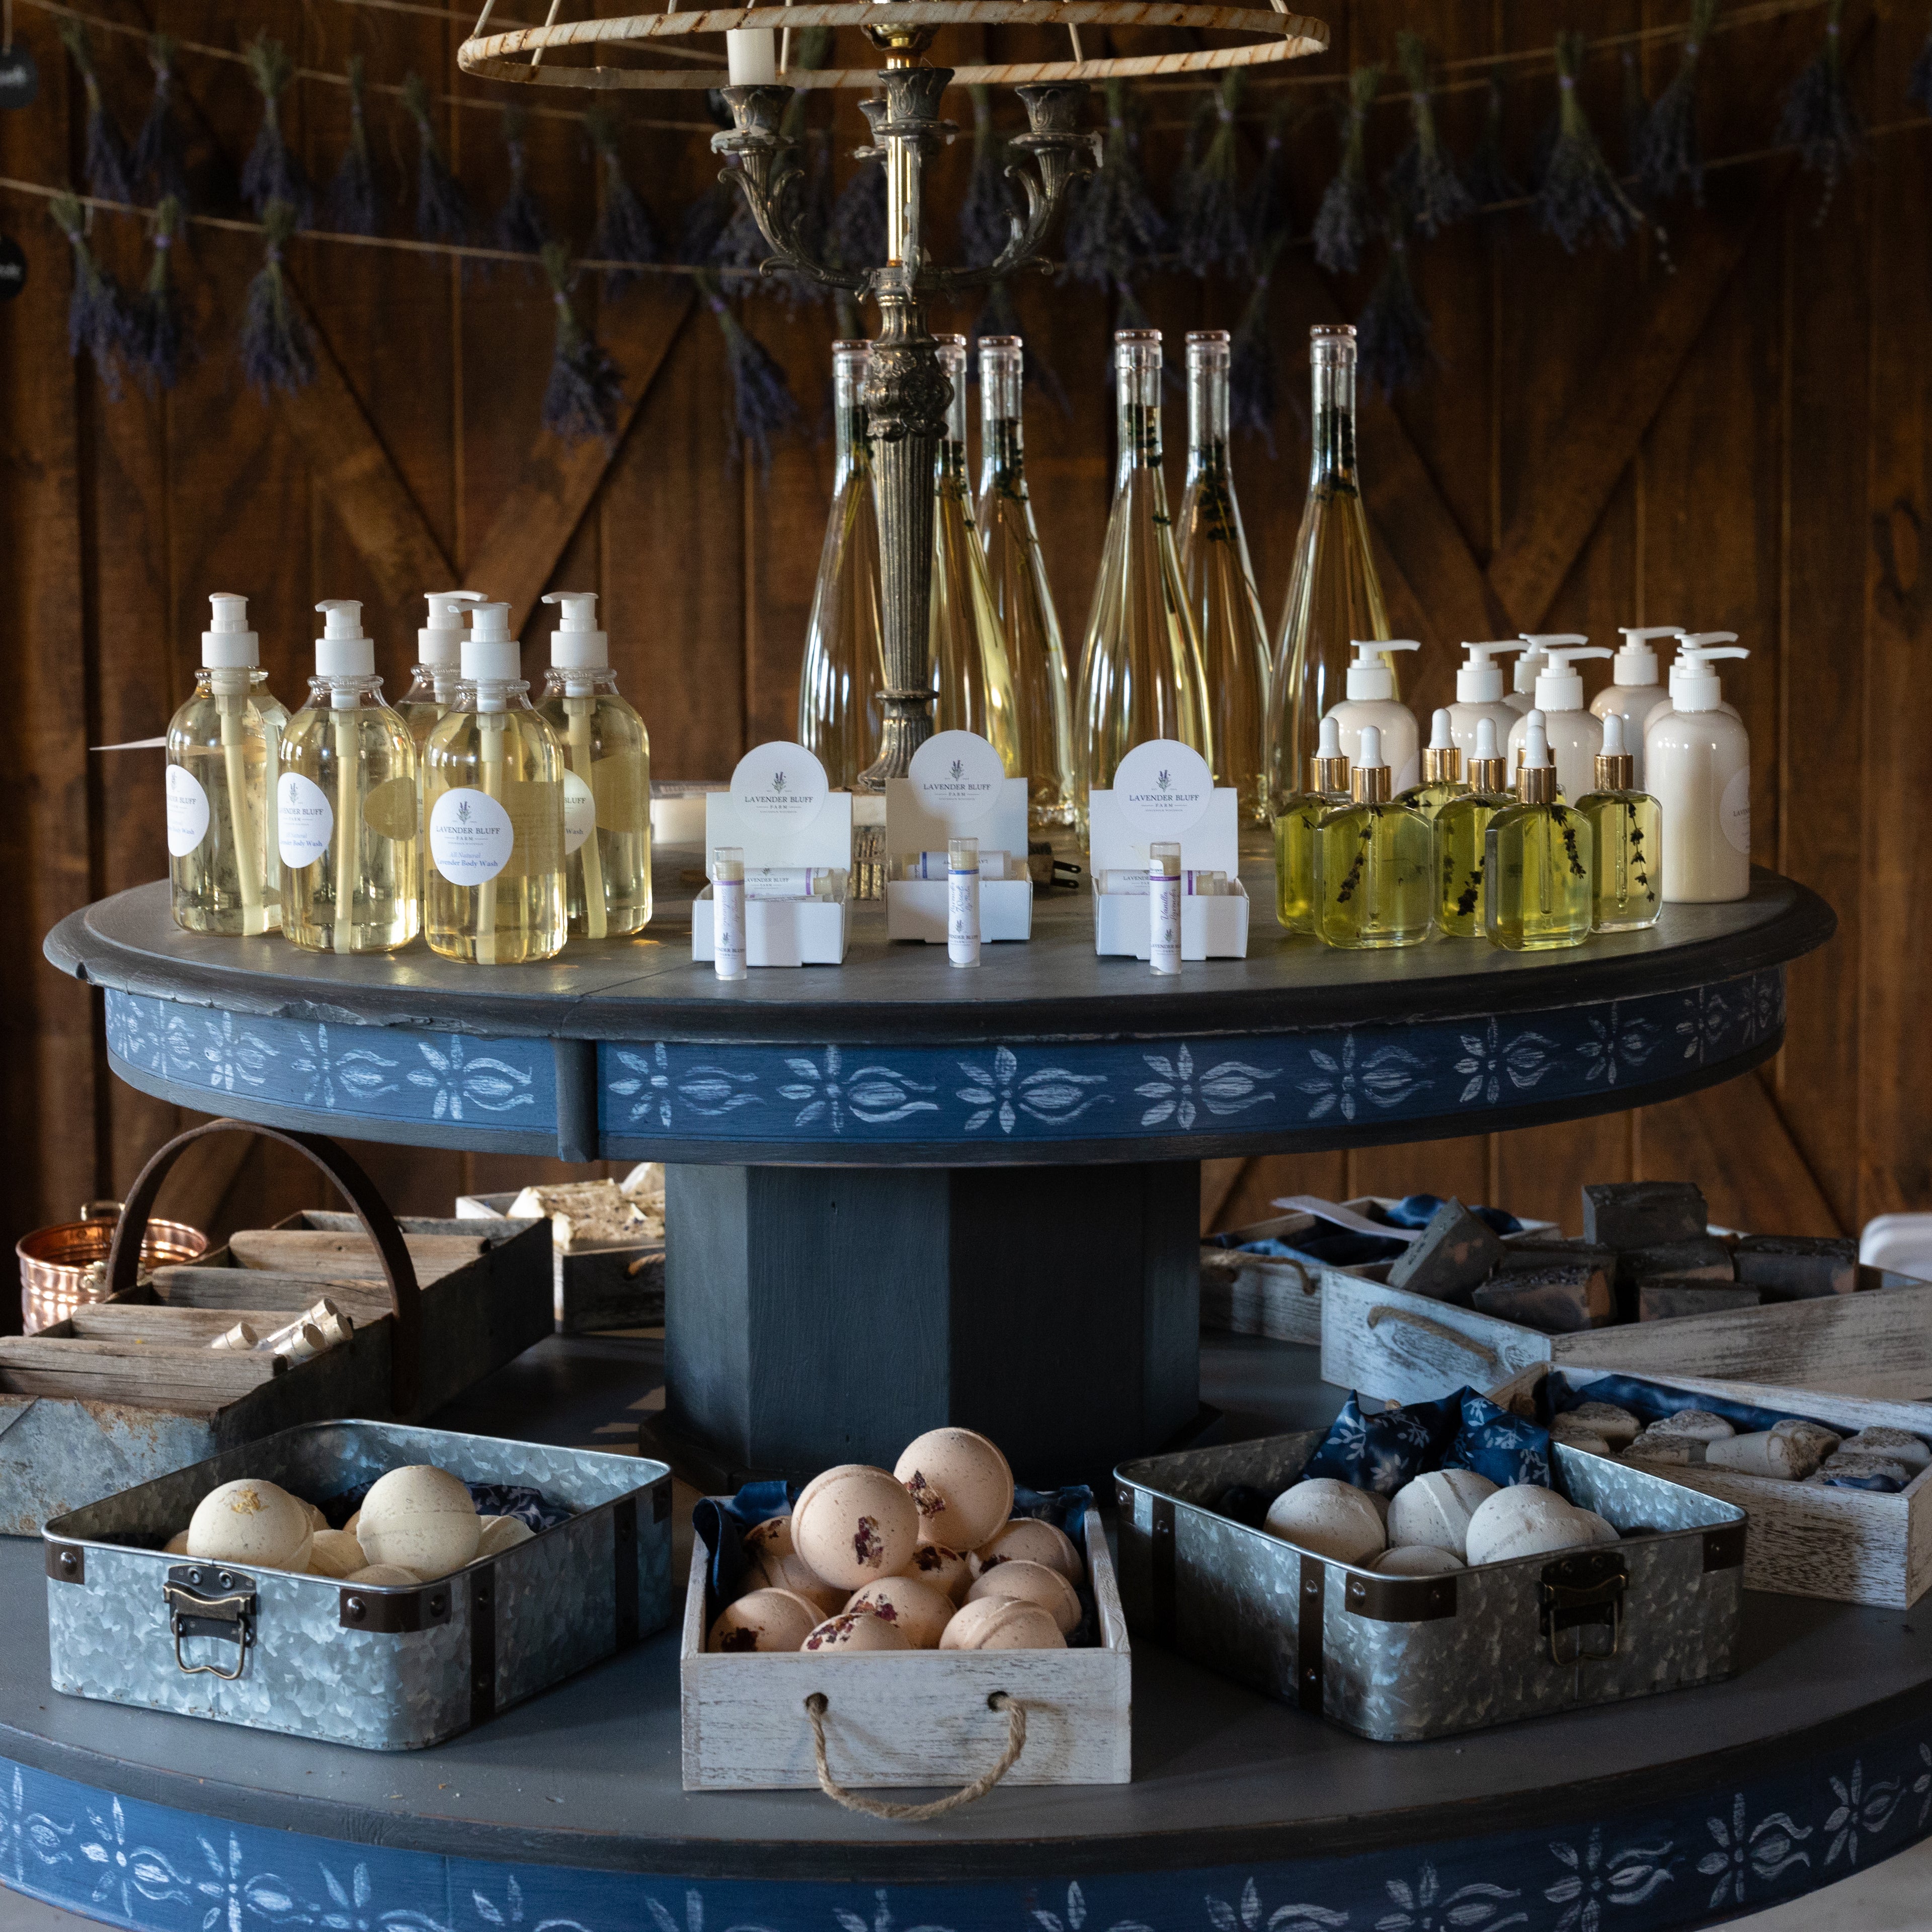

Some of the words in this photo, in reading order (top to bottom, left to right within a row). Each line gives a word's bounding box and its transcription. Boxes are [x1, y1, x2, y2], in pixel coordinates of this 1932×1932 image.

[436, 826, 473, 834] LAVENDER
[461, 859, 478, 868] Body
[1160, 890, 1169, 921] Vanilla
